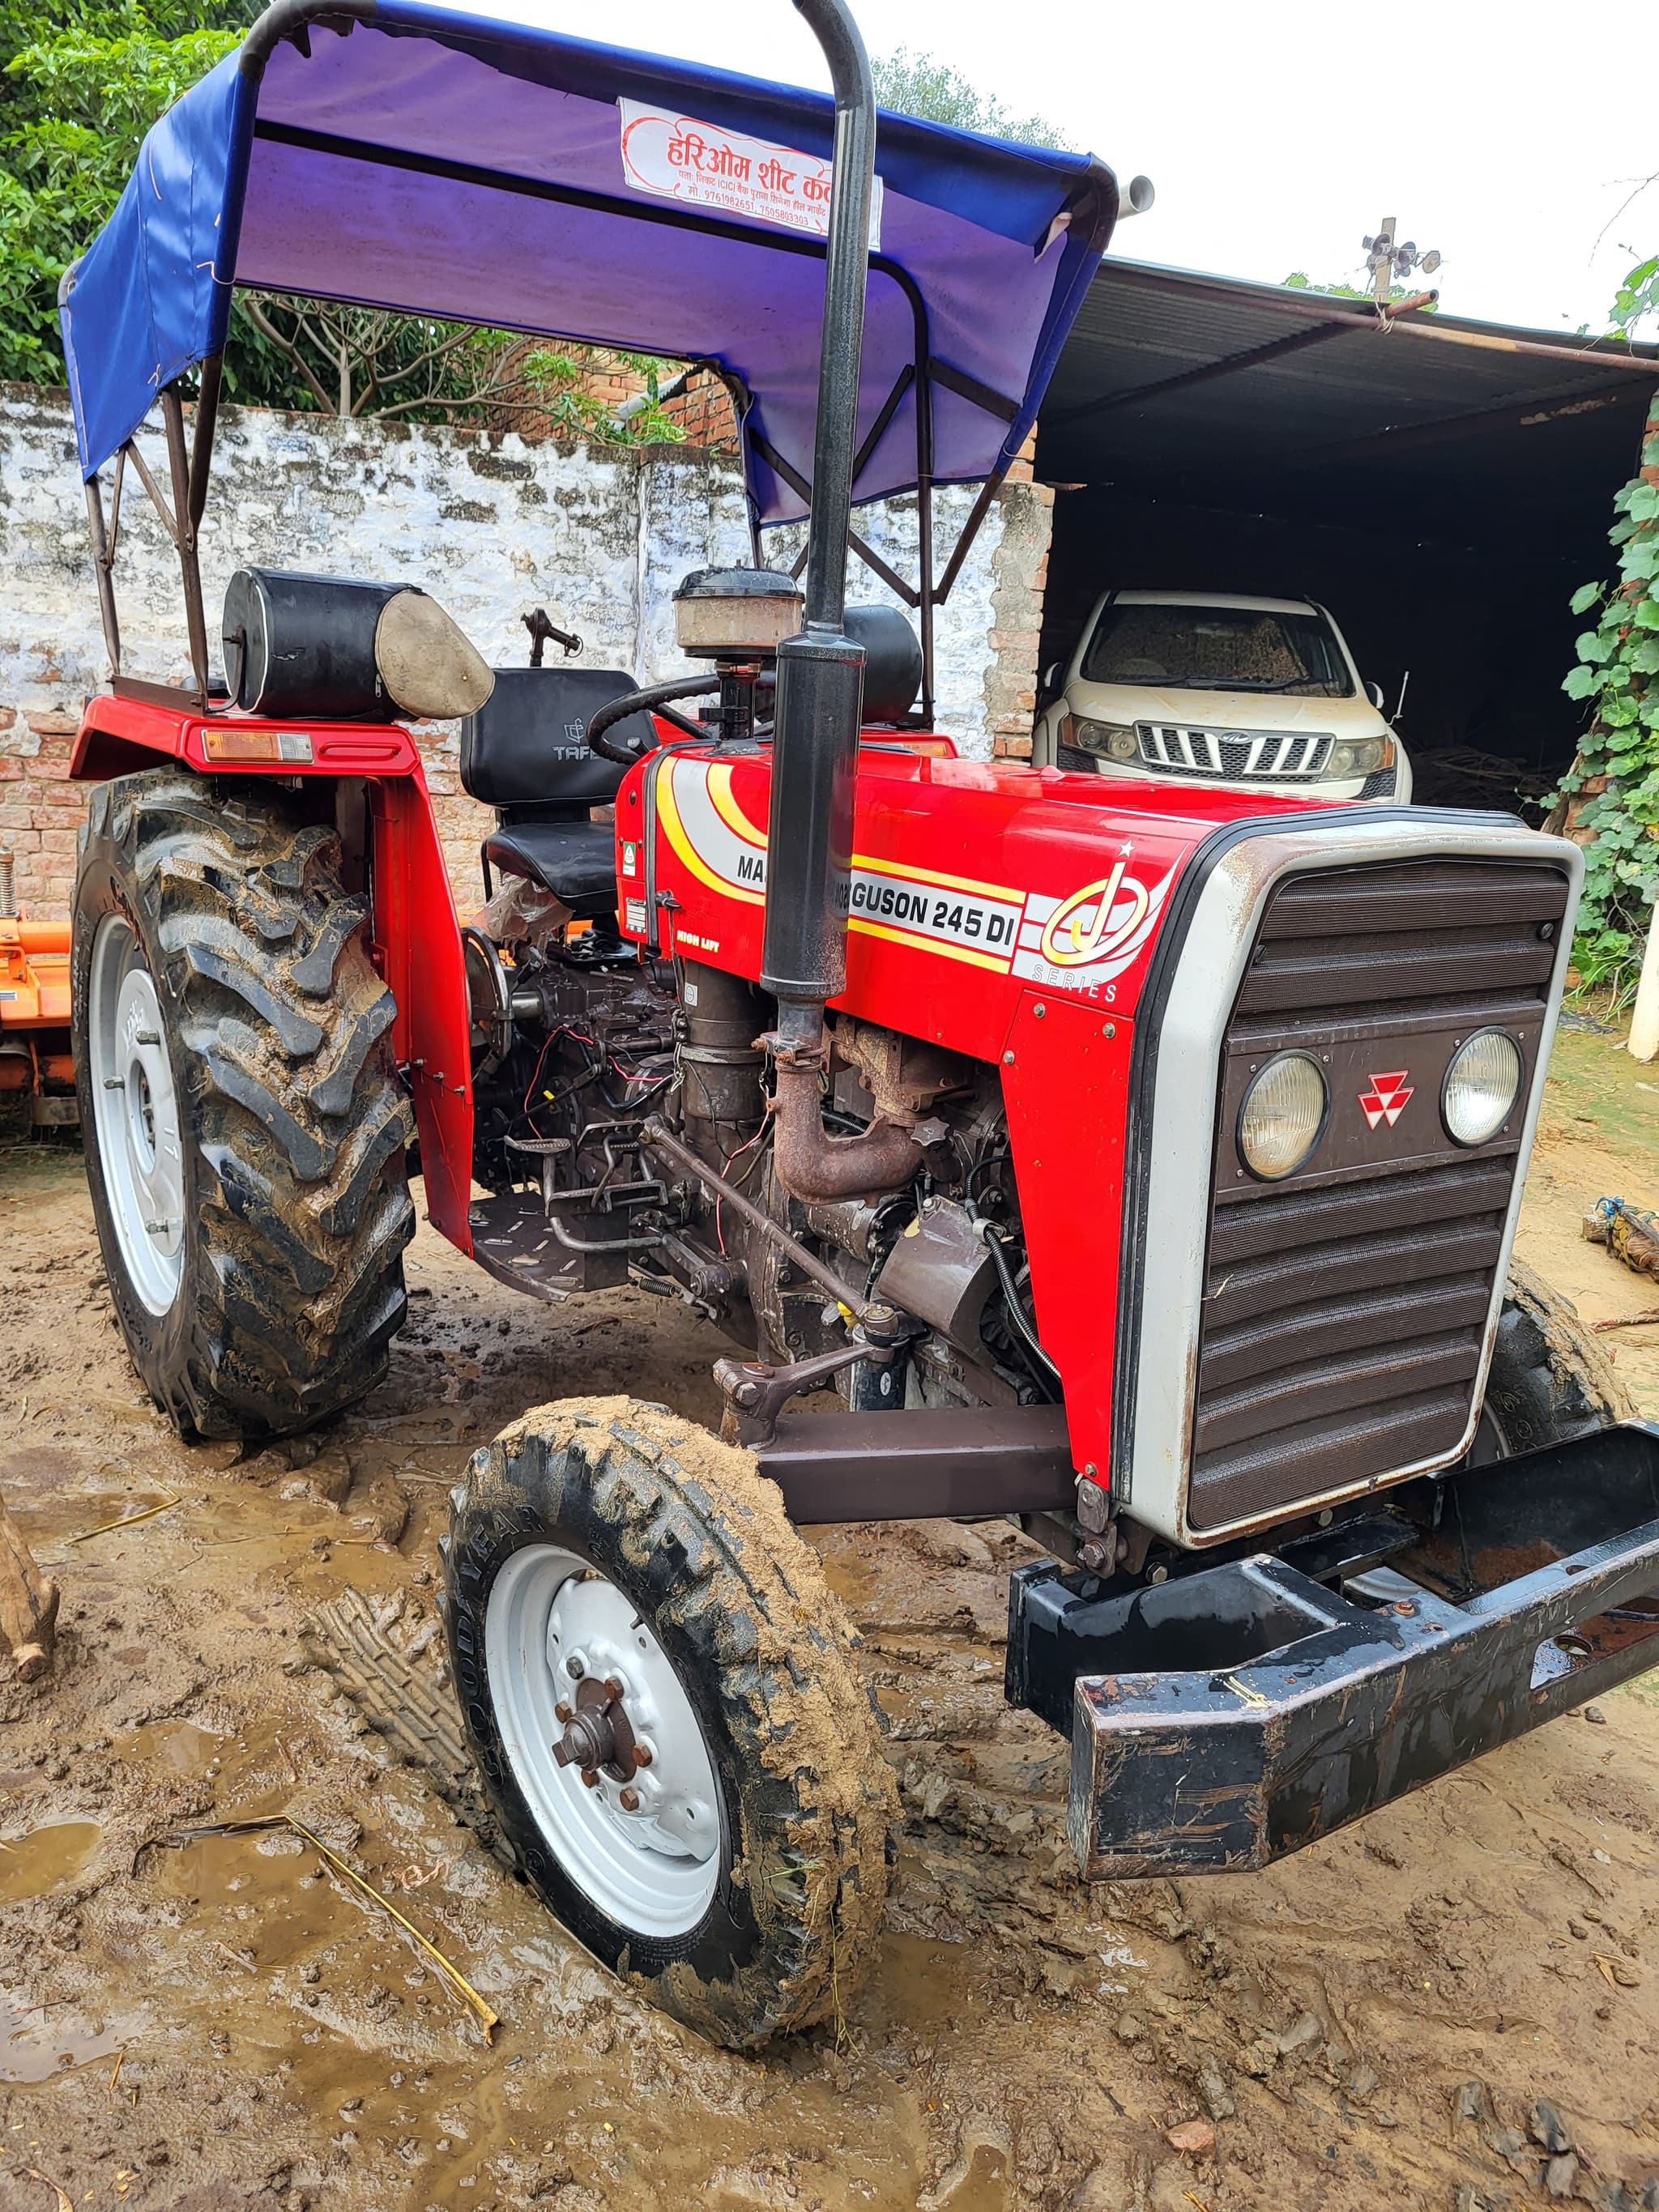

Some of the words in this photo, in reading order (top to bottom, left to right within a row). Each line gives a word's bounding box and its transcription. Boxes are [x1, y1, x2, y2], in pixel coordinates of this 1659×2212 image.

[667, 133, 752, 182] हरिओम
[757, 158, 797, 194] शीट
[737, 855, 767, 883] MA
[851, 882, 928, 924] GUSON
[932, 901, 983, 937] 245
[986, 914, 1016, 946] DI
[676, 929, 699, 947] HIGH
[701, 937, 720, 953] LIFT
[1031, 964, 1117, 1003] SERIES
